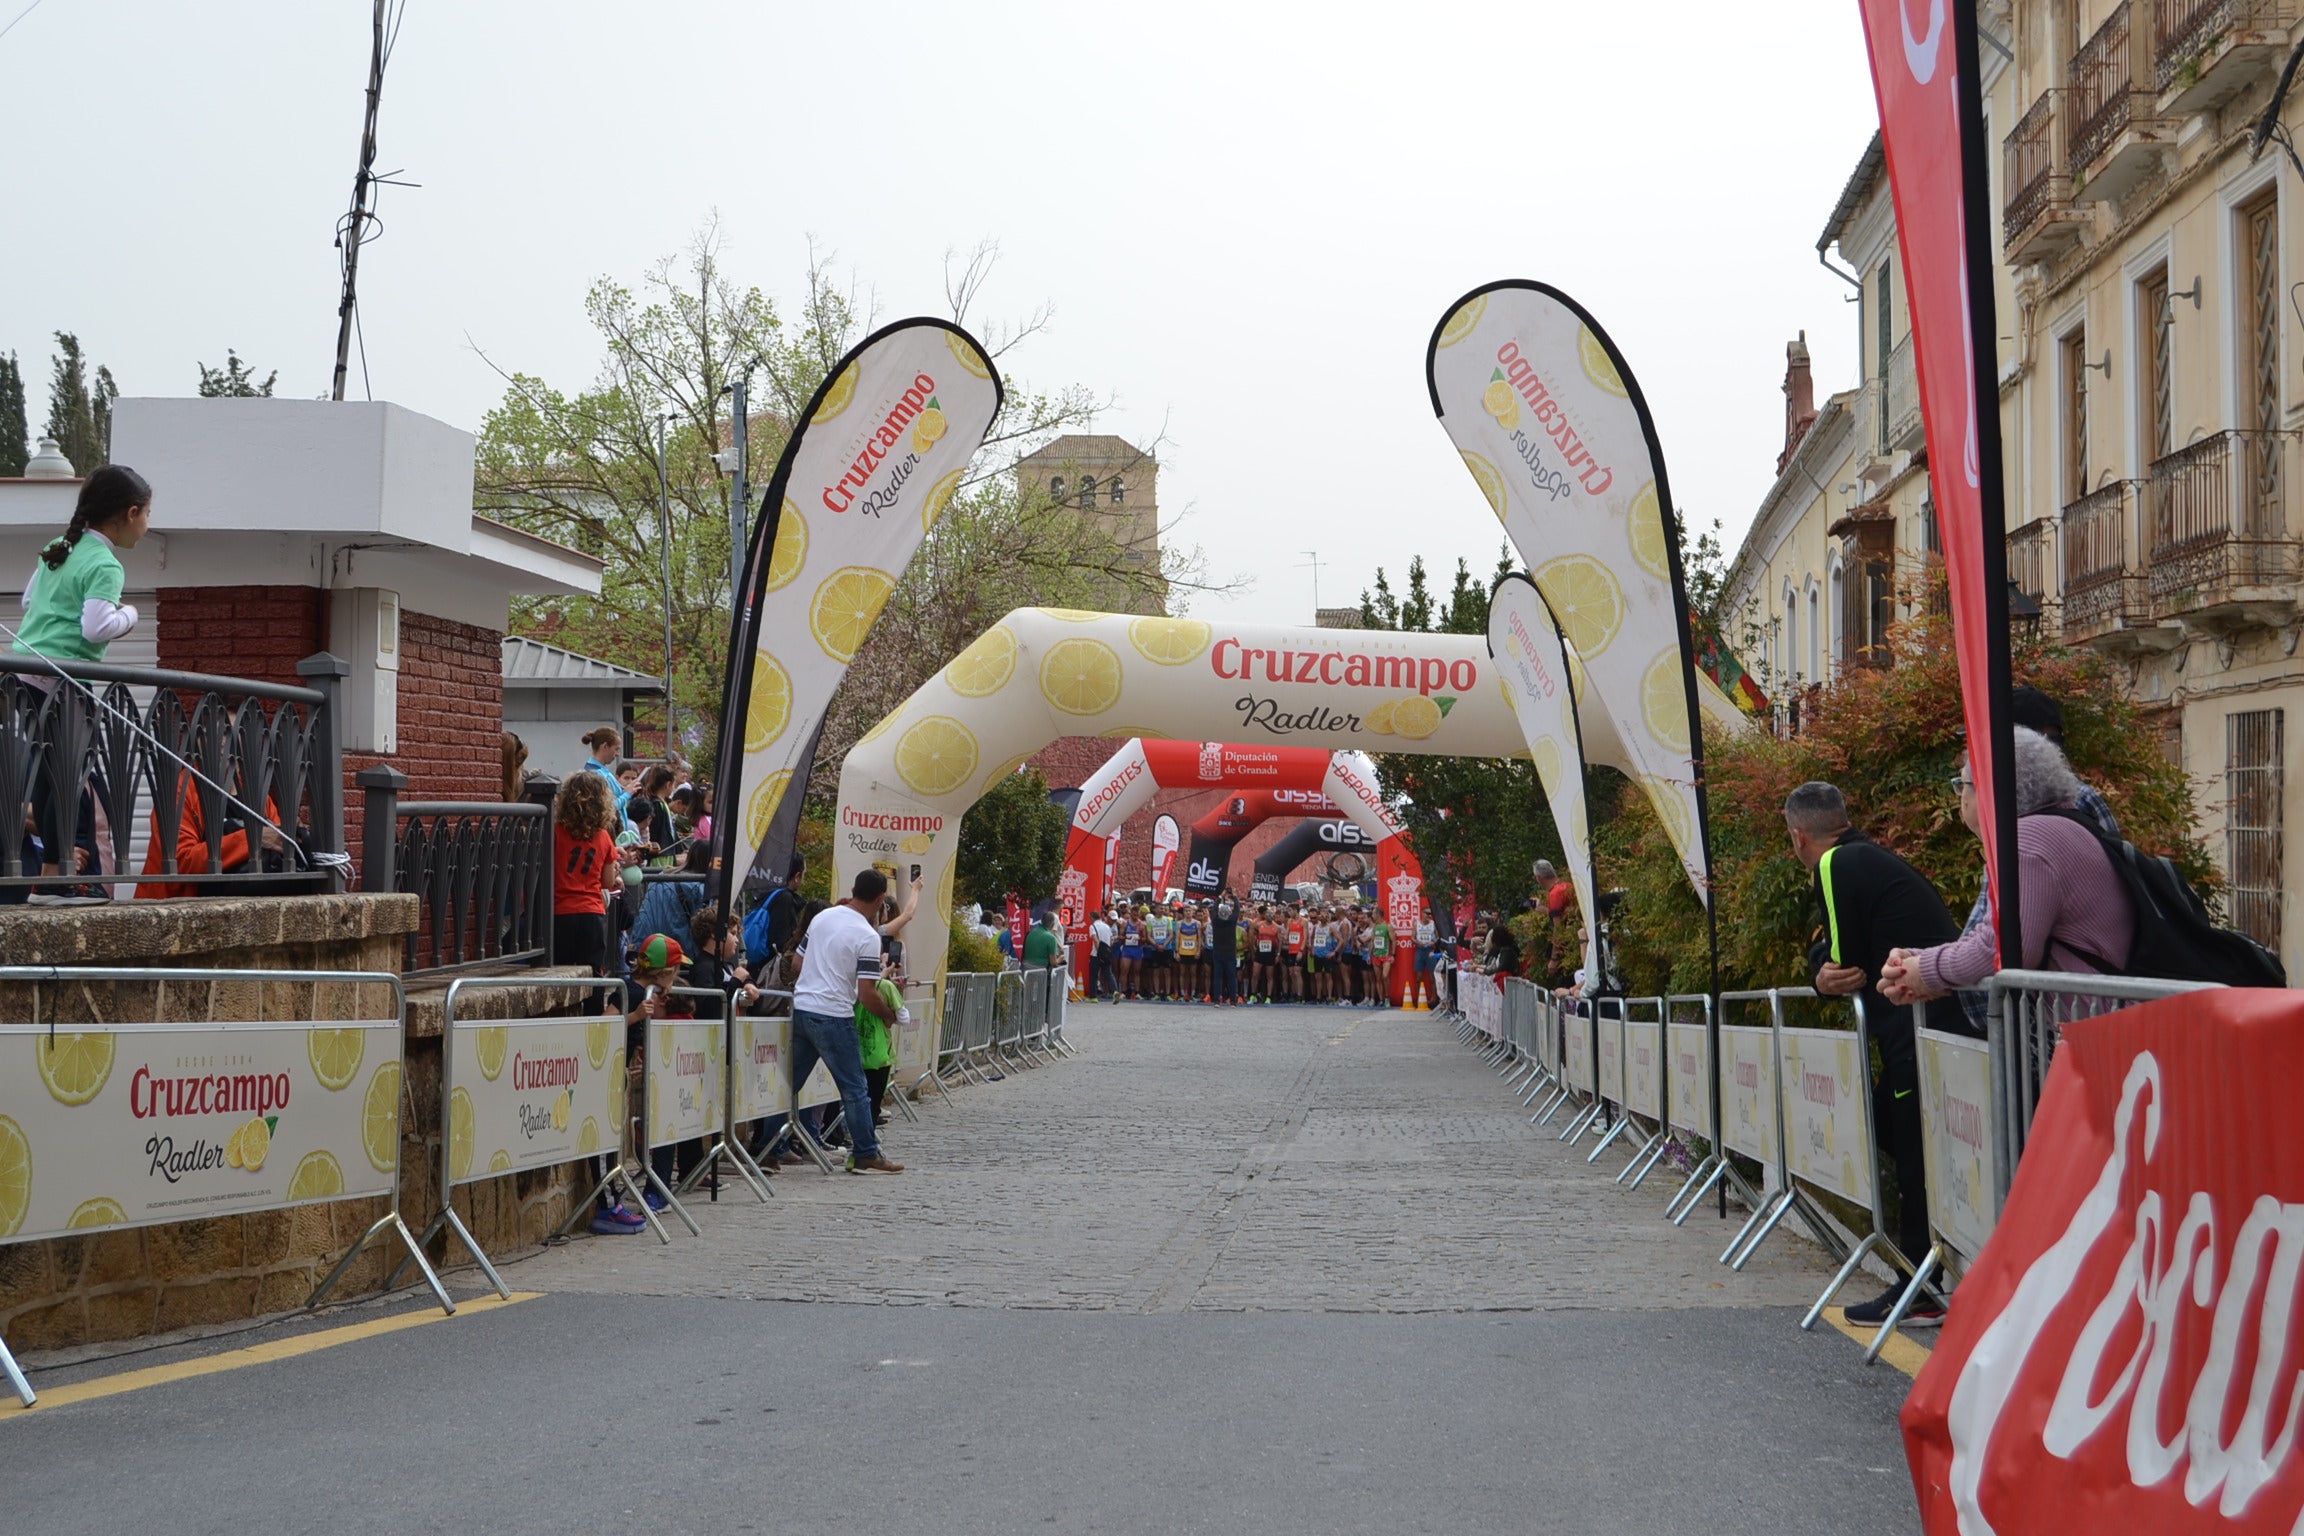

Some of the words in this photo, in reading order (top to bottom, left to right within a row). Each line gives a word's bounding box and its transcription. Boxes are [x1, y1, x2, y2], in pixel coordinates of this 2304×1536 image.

[822, 373, 936, 513] Cruzcampo
[862, 453, 921, 518] Radler
[1211, 636, 1477, 696] Cruzcampo
[1235, 693, 1363, 734] Radler
[1224, 765, 1236, 775] de
[1238, 765, 1278, 775] Granada
[1225, 751, 1278, 762] Diputación
[1078, 760, 1142, 824] DEPORTES
[843, 804, 943, 834] Cruzcampo
[565, 845, 596, 875] 11
[848, 833, 898, 853] Radler
[131, 1063, 291, 1119] Cruzcampo
[514, 1050, 579, 1091] Cruzcampo
[519, 1101, 551, 1139] Radler
[146, 1132, 225, 1183] Radler
